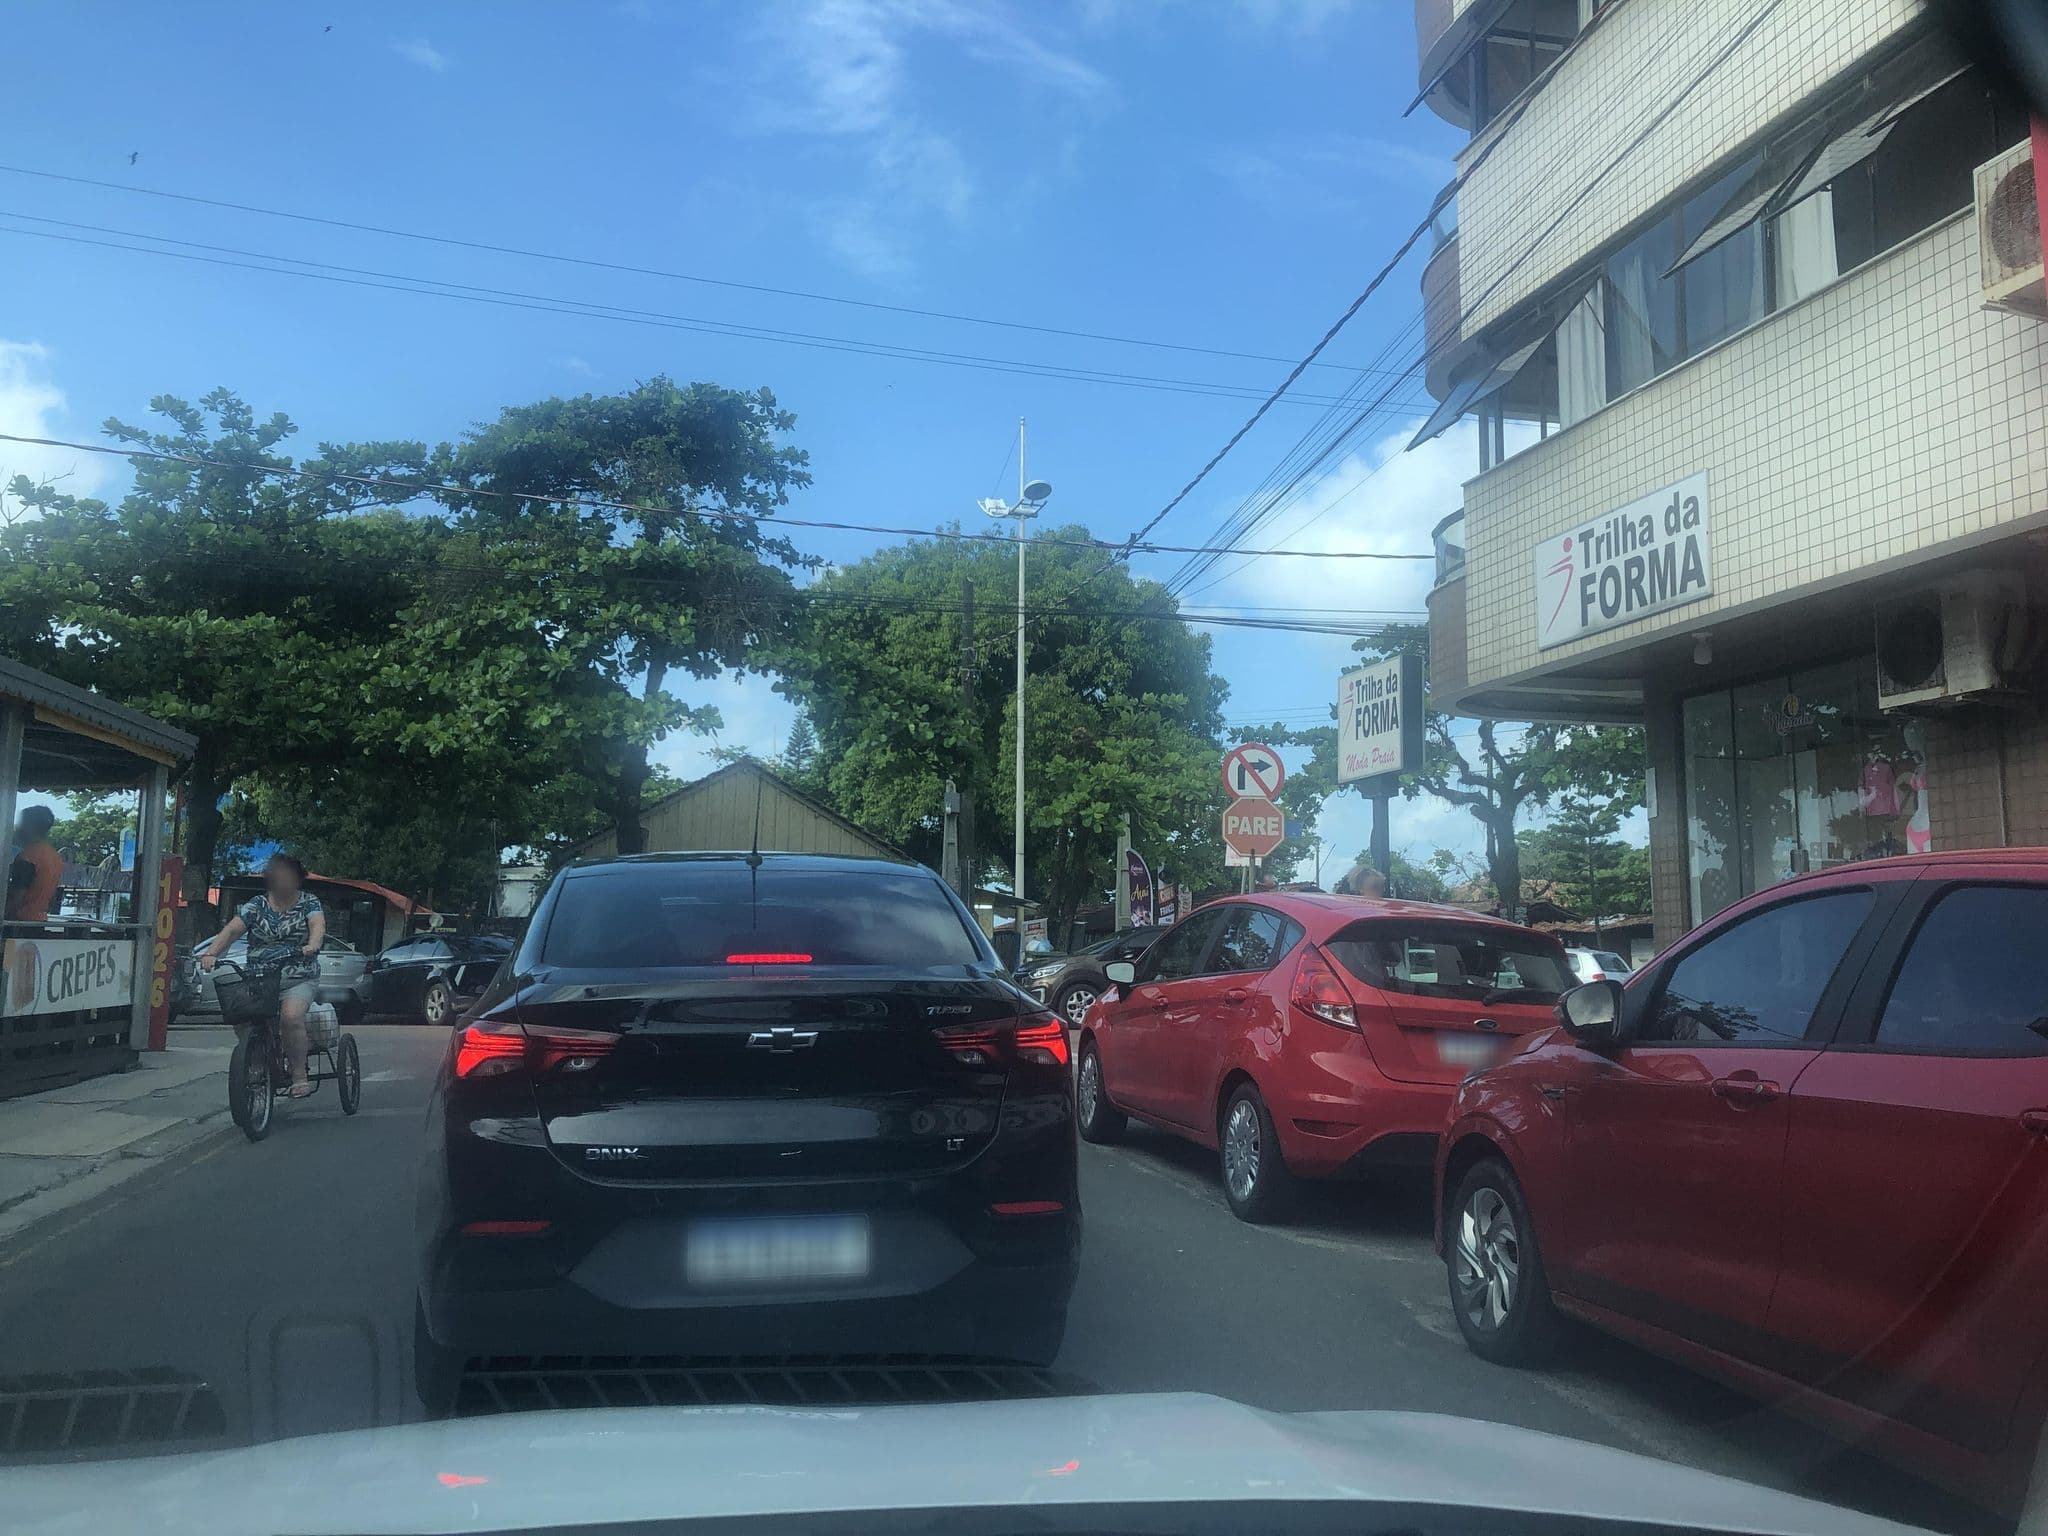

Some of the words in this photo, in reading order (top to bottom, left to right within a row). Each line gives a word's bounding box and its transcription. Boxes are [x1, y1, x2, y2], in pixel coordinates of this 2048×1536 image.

[1578, 514, 1655, 569] Trilha
[1664, 490, 1701, 537] da
[1579, 533, 1706, 627] FORMA
[1355, 674, 1383, 704] Trilha
[1385, 668, 1398, 695] da
[1355, 696, 1399, 740] FORMA
[1346, 752, 1369, 773] Moda
[1372, 747, 1395, 769] Praia
[1227, 815, 1280, 836] PARE
[152, 872, 173, 1008] 1026
[47, 944, 116, 1003] CREPES
[585, 1147, 639, 1160] ONIX
[947, 1138, 964, 1151] LT
